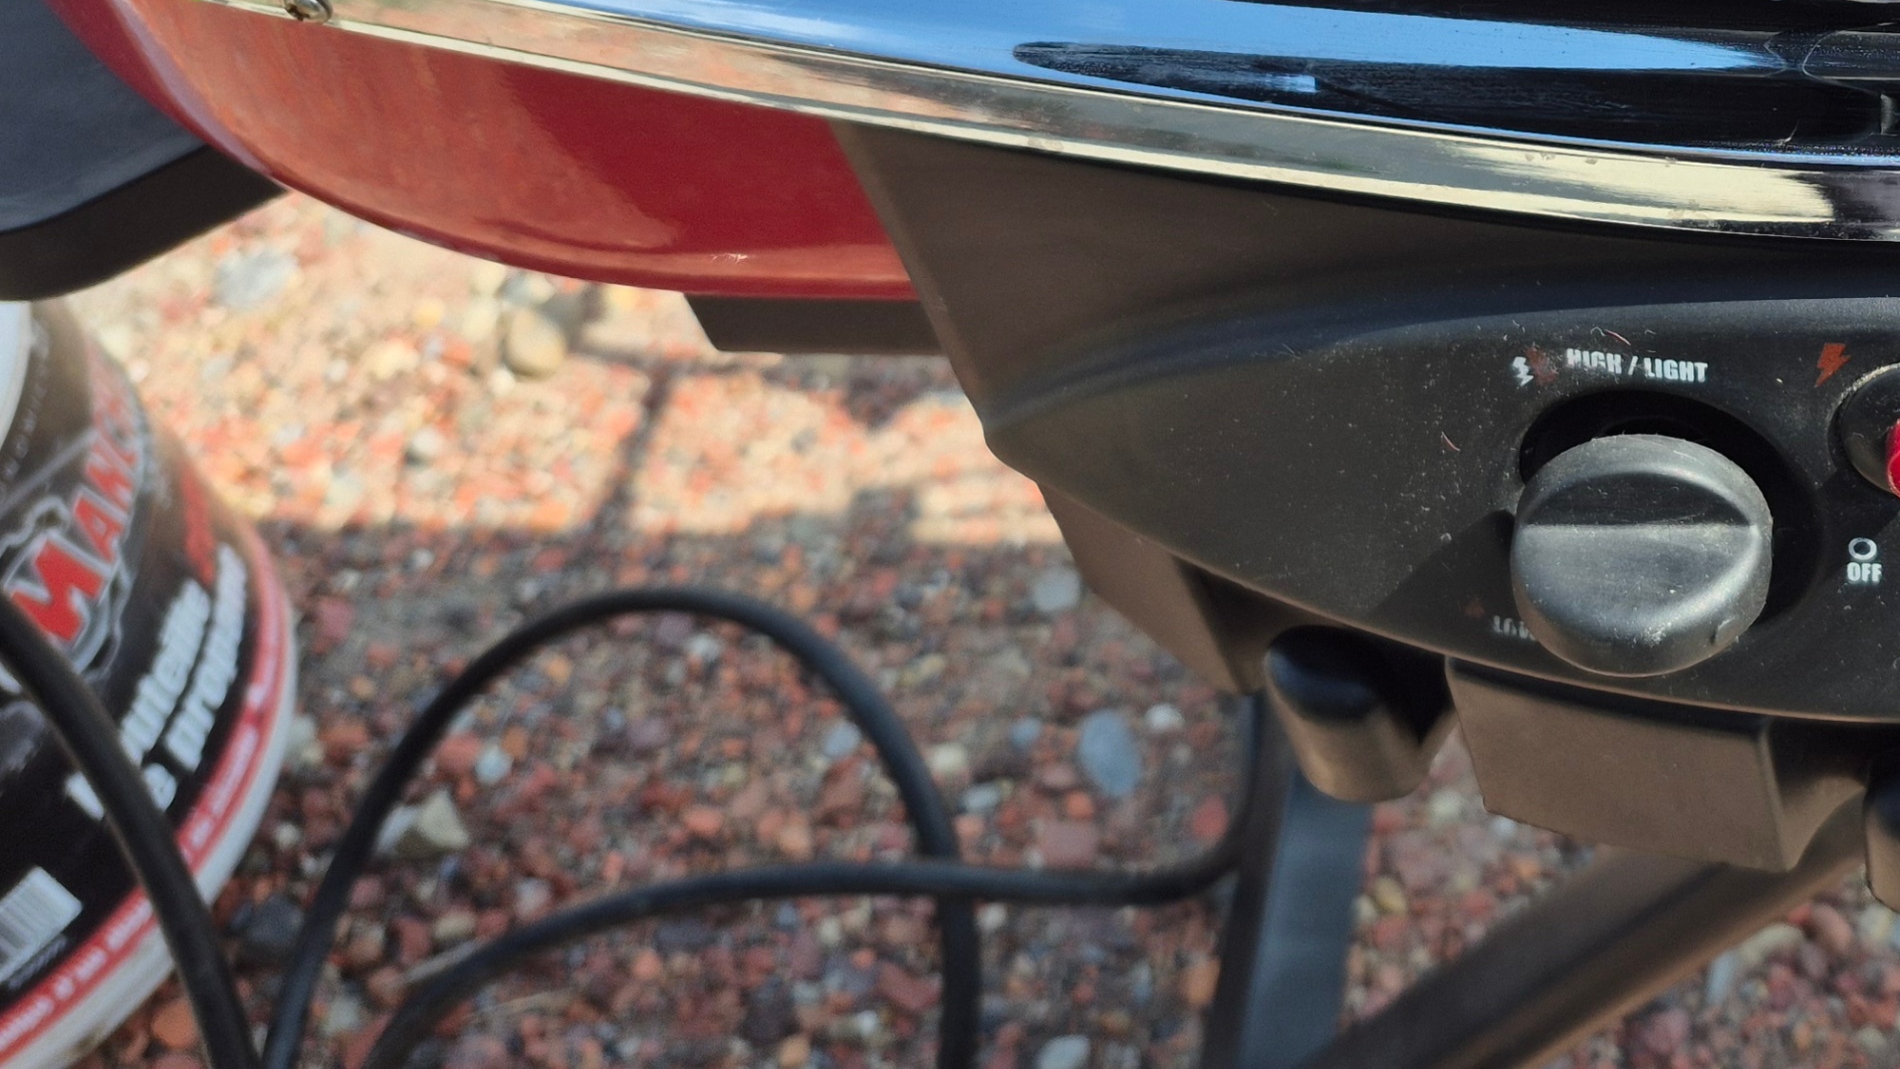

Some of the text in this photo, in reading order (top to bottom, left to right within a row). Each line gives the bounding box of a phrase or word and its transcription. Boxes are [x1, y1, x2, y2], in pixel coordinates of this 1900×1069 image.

[1566, 348, 1622, 374] HIGH
[1644, 357, 1709, 383] LIGHT
[1846, 560, 1884, 585] OFF
